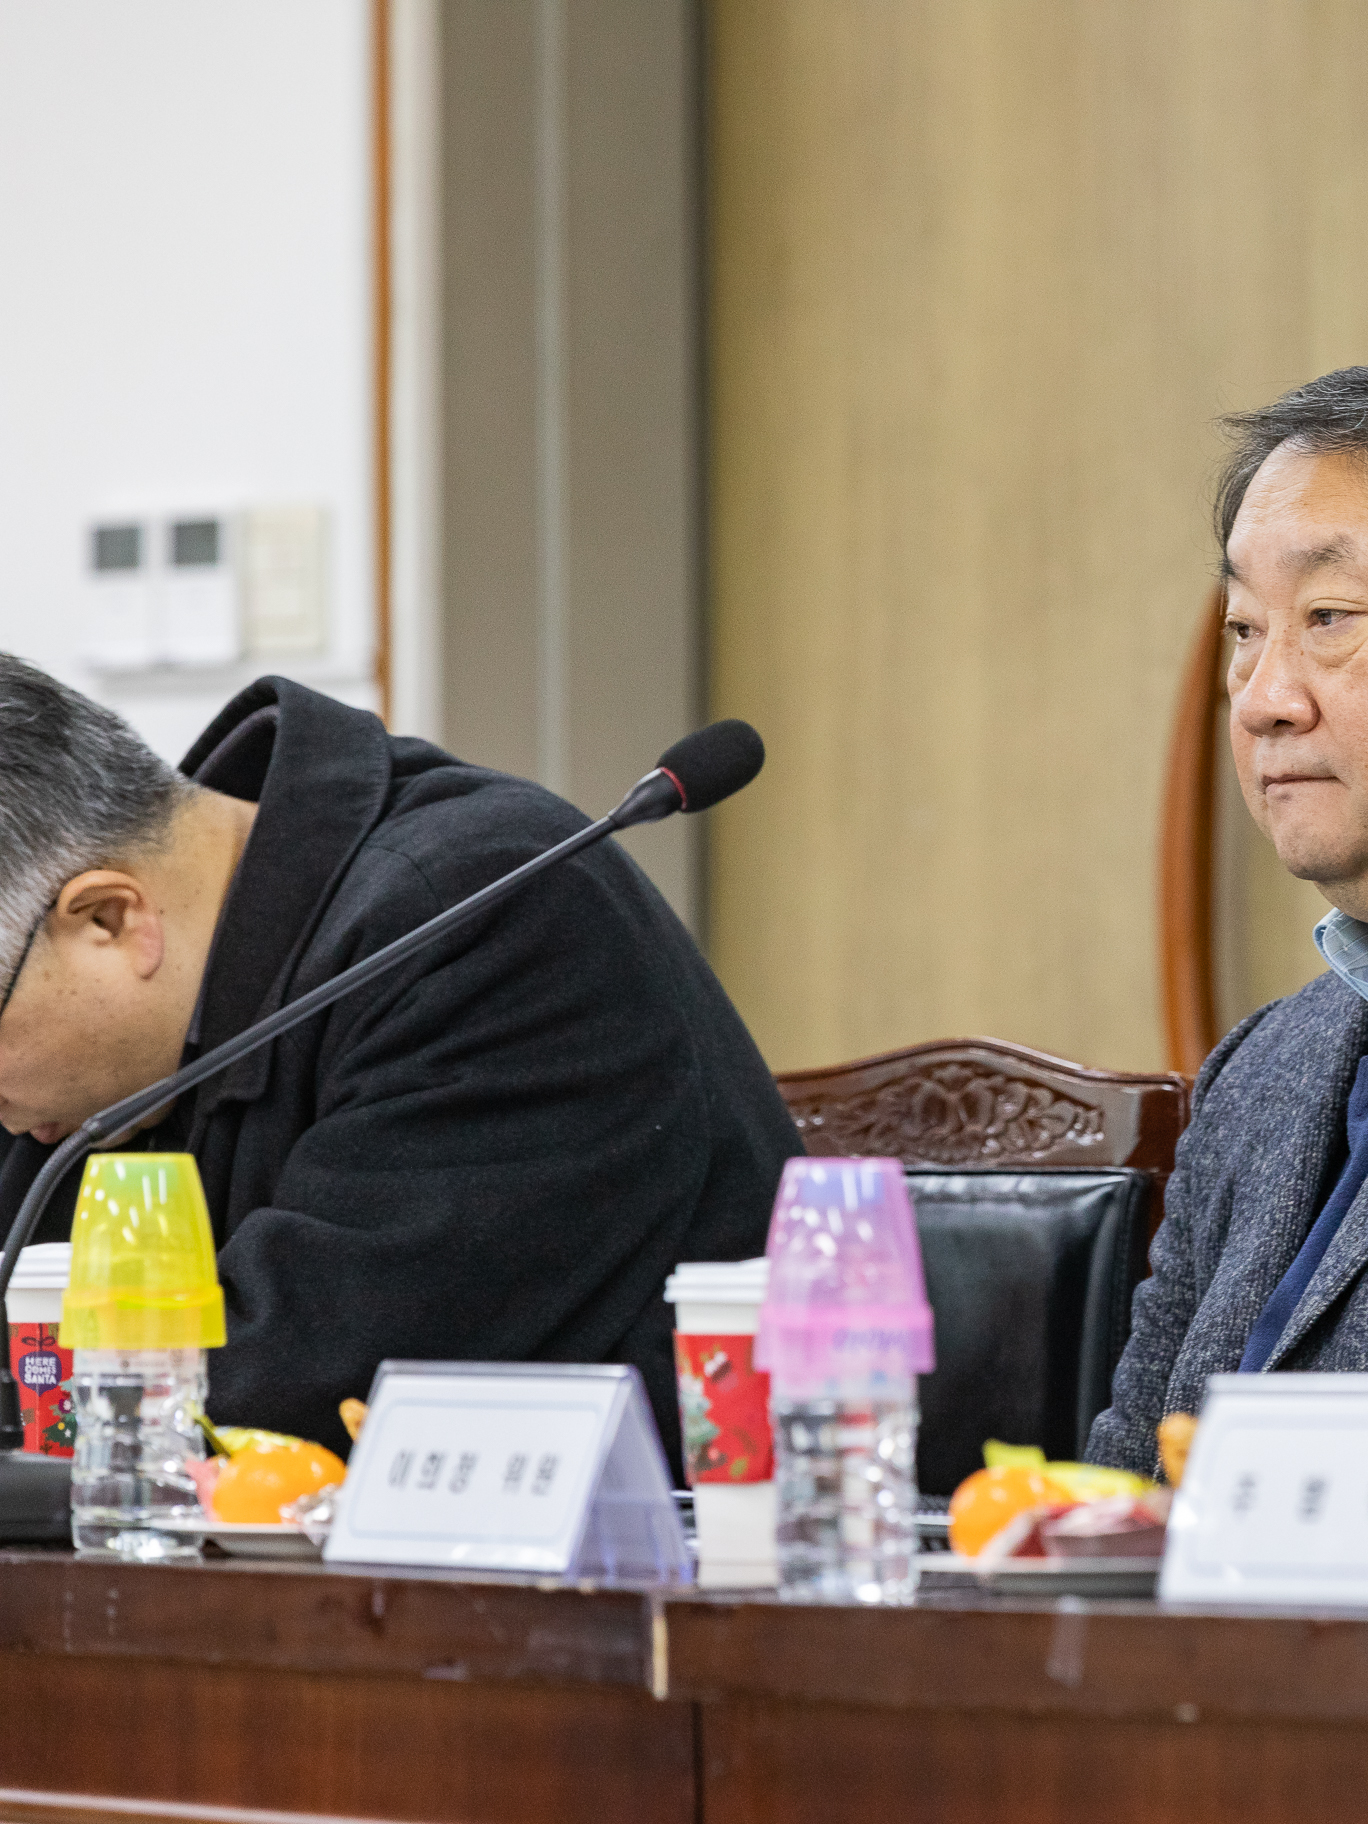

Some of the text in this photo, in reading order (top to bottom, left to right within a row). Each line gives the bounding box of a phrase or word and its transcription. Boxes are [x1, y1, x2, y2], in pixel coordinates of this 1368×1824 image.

[25, 1357, 56, 1366] HERE
[25, 1365, 57, 1375] COMES
[24, 1374, 57, 1385] SANTA
